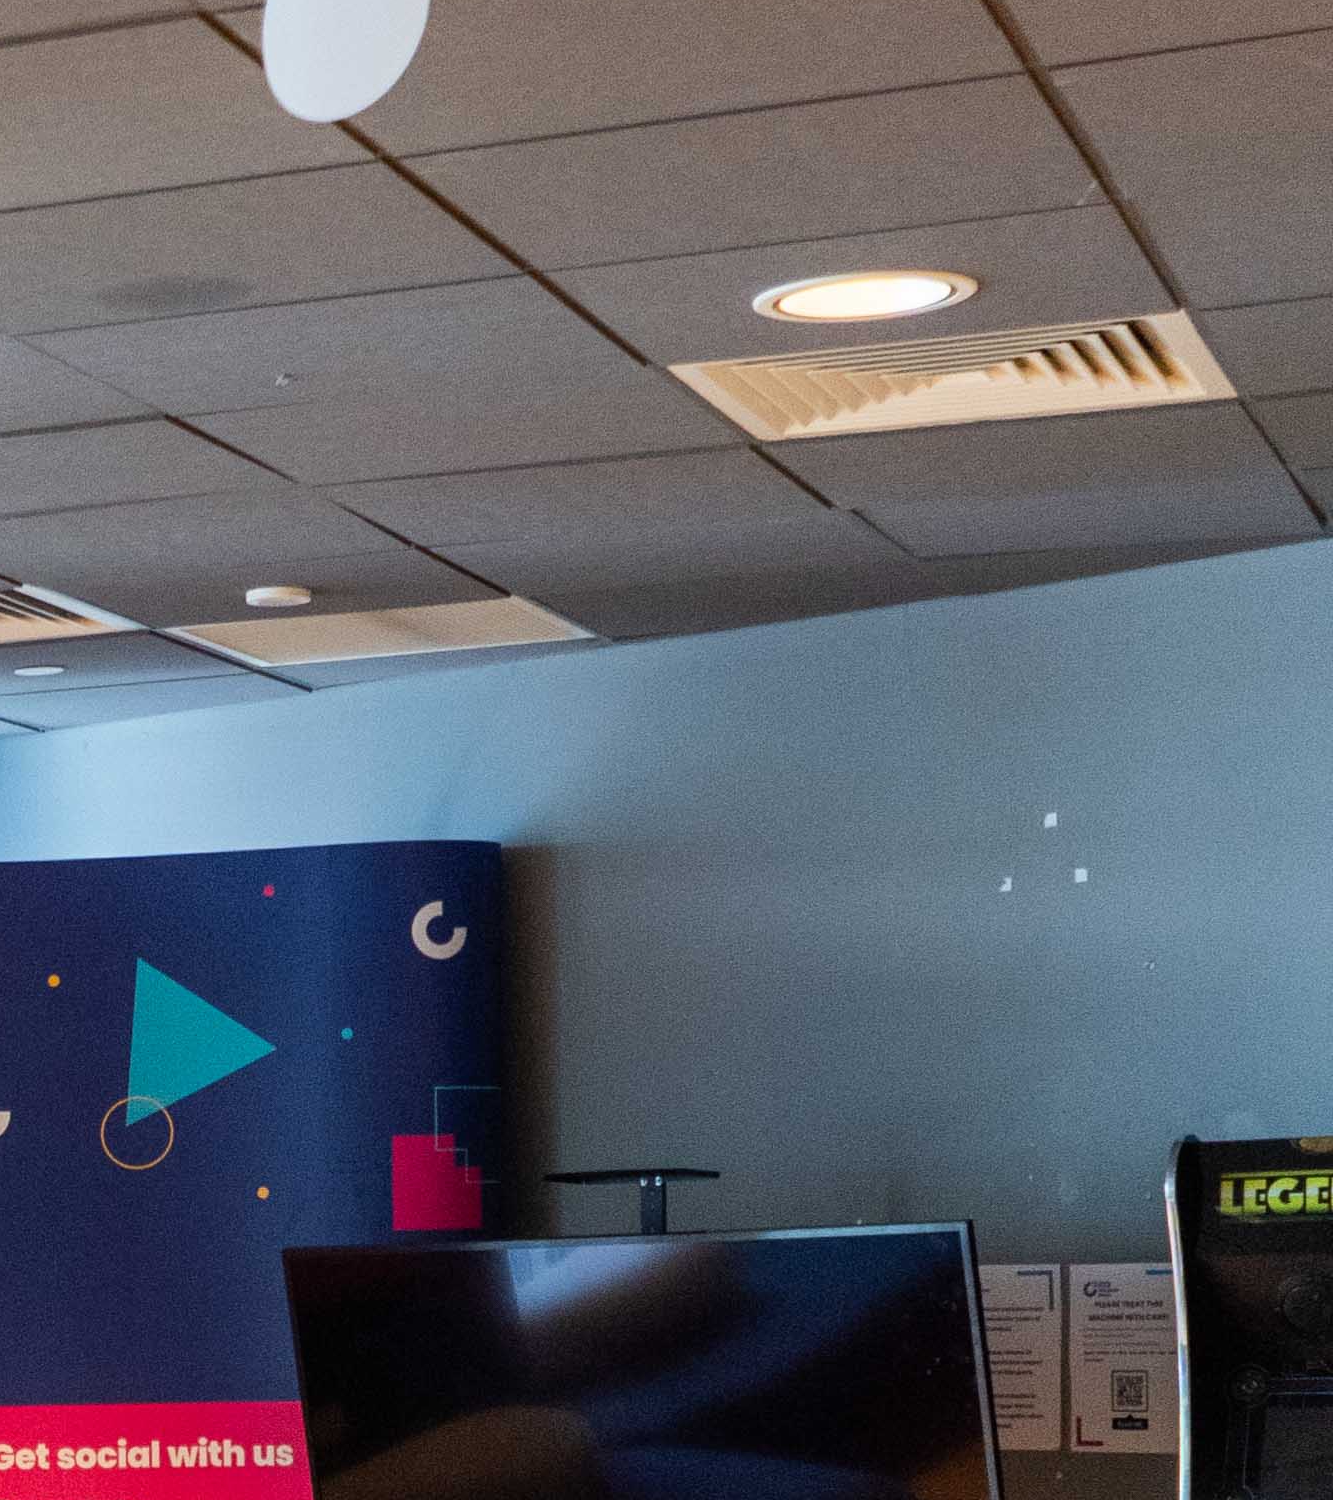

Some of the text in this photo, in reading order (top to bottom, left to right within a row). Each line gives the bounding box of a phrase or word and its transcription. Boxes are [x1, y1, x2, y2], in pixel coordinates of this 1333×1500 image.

[1220, 1177, 1333, 1214] LEGE
[56, 1437, 161, 1470] social
[166, 1436, 246, 1468] with
[252, 1443, 295, 1467] us
